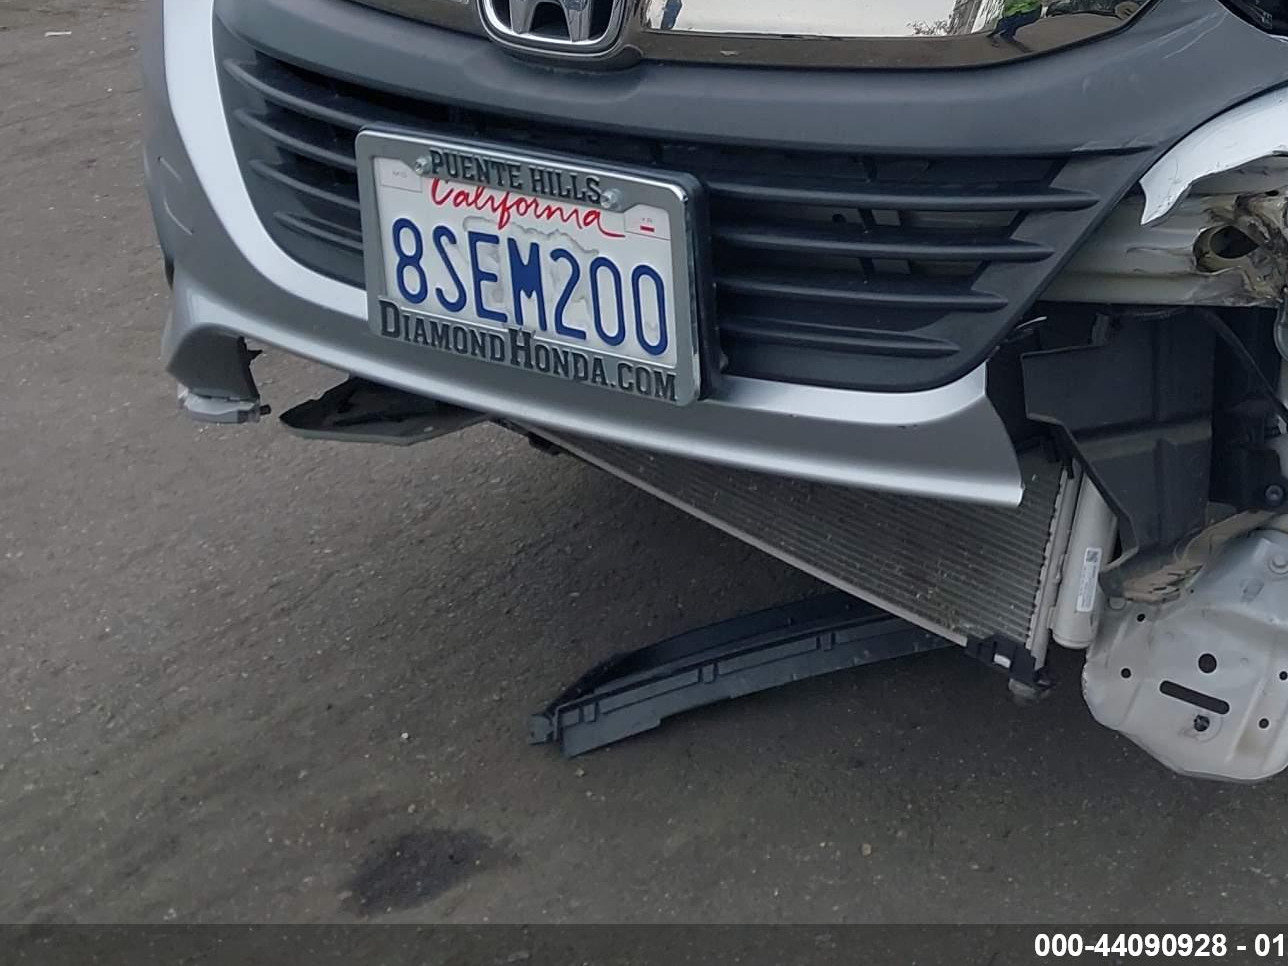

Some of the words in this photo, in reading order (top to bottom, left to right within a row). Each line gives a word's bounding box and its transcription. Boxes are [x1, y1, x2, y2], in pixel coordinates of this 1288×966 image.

[429, 149, 522, 191] PUENTE
[529, 165, 601, 204] HILLS
[430, 178, 626, 238] California
[391, 217, 669, 357] 8SEM200
